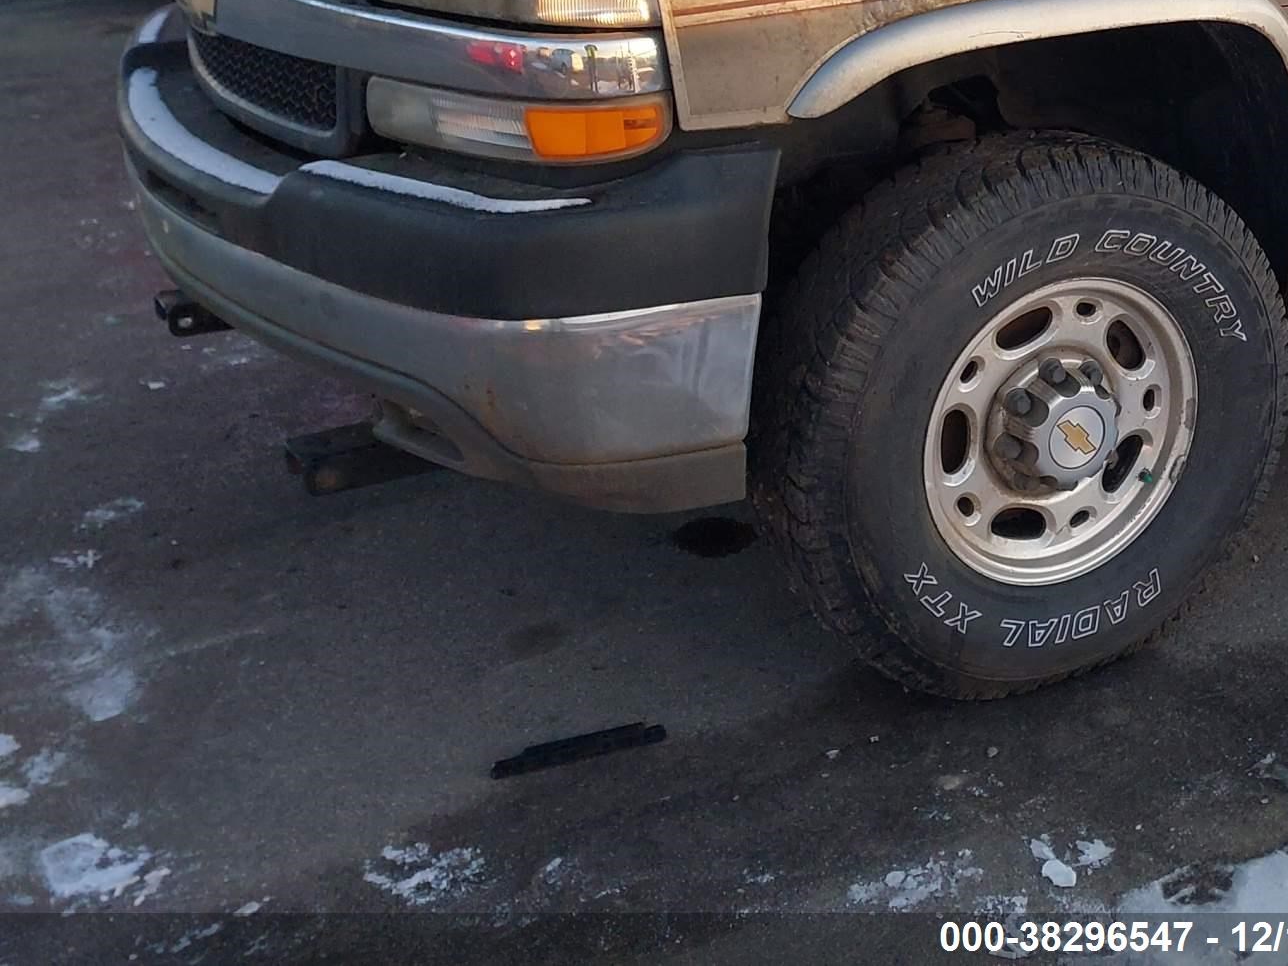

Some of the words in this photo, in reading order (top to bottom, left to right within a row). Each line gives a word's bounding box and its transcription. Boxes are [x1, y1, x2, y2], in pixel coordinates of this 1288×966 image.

[970, 233, 1081, 307] WILD
[1094, 229, 1248, 343] COUNTRY
[903, 562, 983, 634] XTX
[1000, 567, 1162, 649] RADIAL
